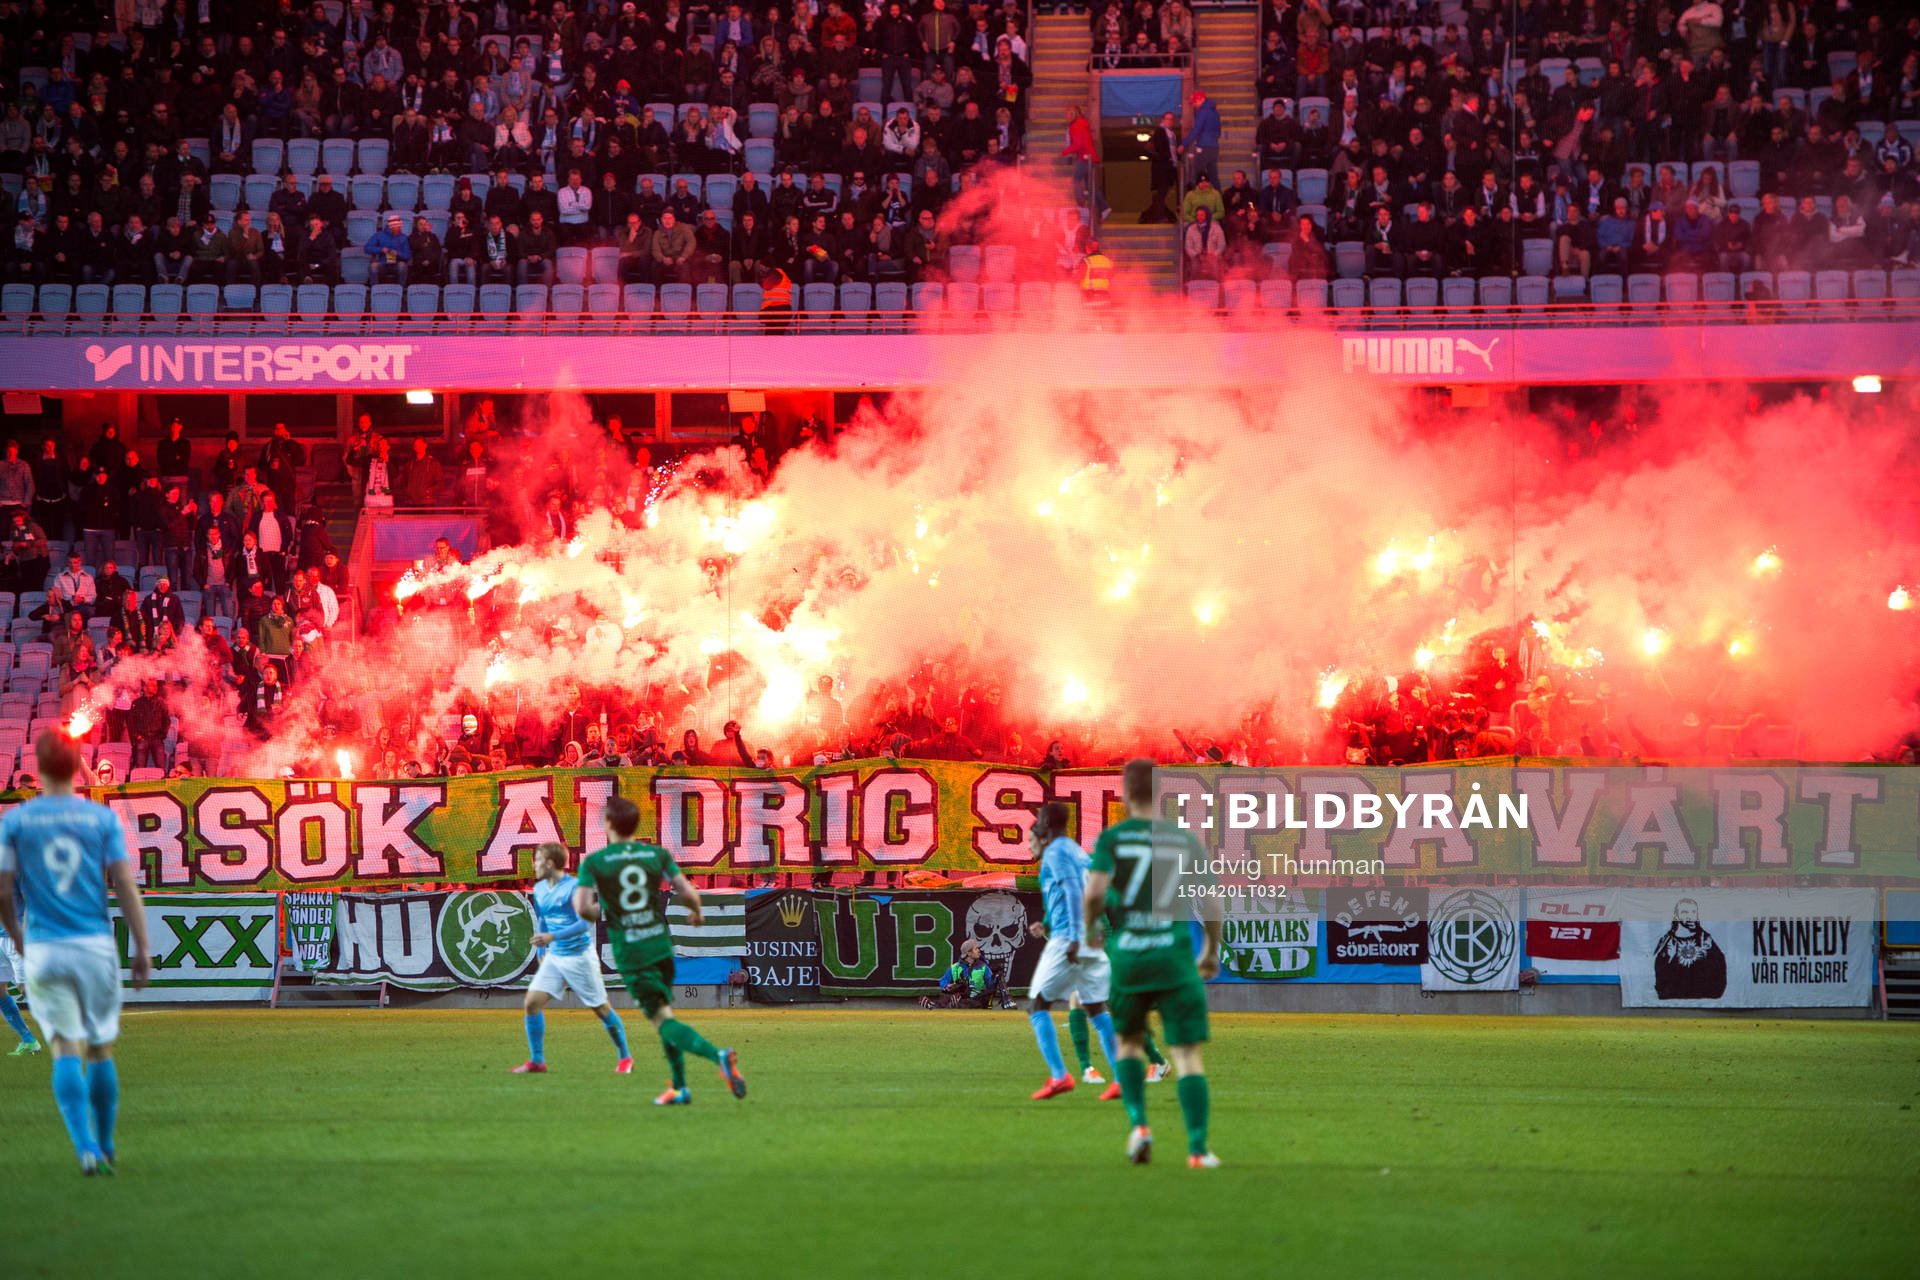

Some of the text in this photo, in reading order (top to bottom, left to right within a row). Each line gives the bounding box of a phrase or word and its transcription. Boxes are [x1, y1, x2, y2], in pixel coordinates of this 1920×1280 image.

[139, 345, 412, 382] INTERSPORT
[1342, 337, 1454, 374] PUMA
[103, 780, 446, 887] RSÖK
[1514, 765, 1885, 870] VÅRT
[43, 836, 82, 893] 9
[1115, 844, 1190, 908] 77
[619, 864, 649, 911] 8
[1335, 889, 1421, 929] DEFEND
[112, 914, 274, 969] LXX
[297, 926, 331, 942] LLA
[812, 897, 954, 981] UB
[1222, 914, 1310, 944] ÖMMARS
[1549, 926, 1592, 940] 121
[1752, 916, 1852, 956] KENNEDY
[300, 943, 329, 961] NDER
[745, 941, 818, 957] BUSINE
[1228, 947, 1310, 972] TAD
[1335, 942, 1420, 958] SÖDERORT
[1752, 957, 1848, 984] VÅR FRÄLSARE
